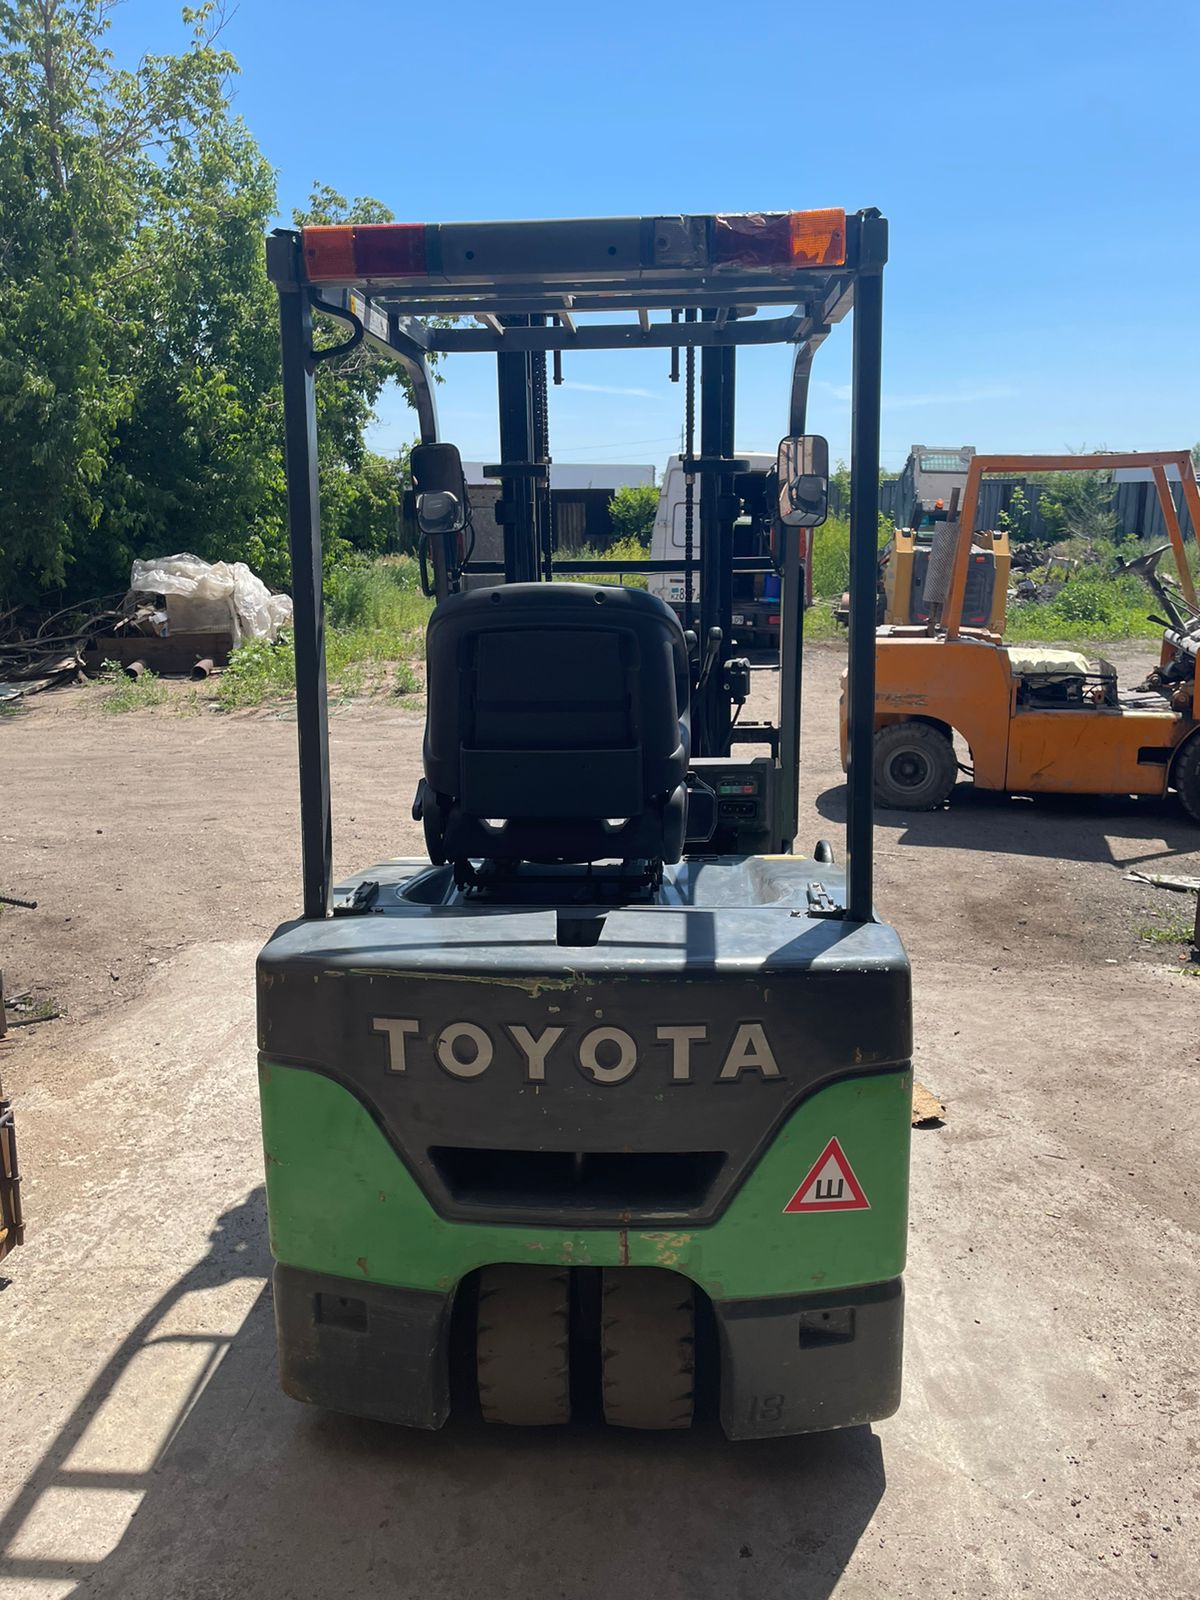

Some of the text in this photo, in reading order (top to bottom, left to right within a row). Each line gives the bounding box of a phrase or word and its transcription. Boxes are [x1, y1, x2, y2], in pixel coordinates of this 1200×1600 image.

[679, 588, 696, 600] 87
[371, 1017, 781, 1083] TOYOTA
[815, 1179, 844, 1199] Ш
[750, 1393, 785, 1421] 18
